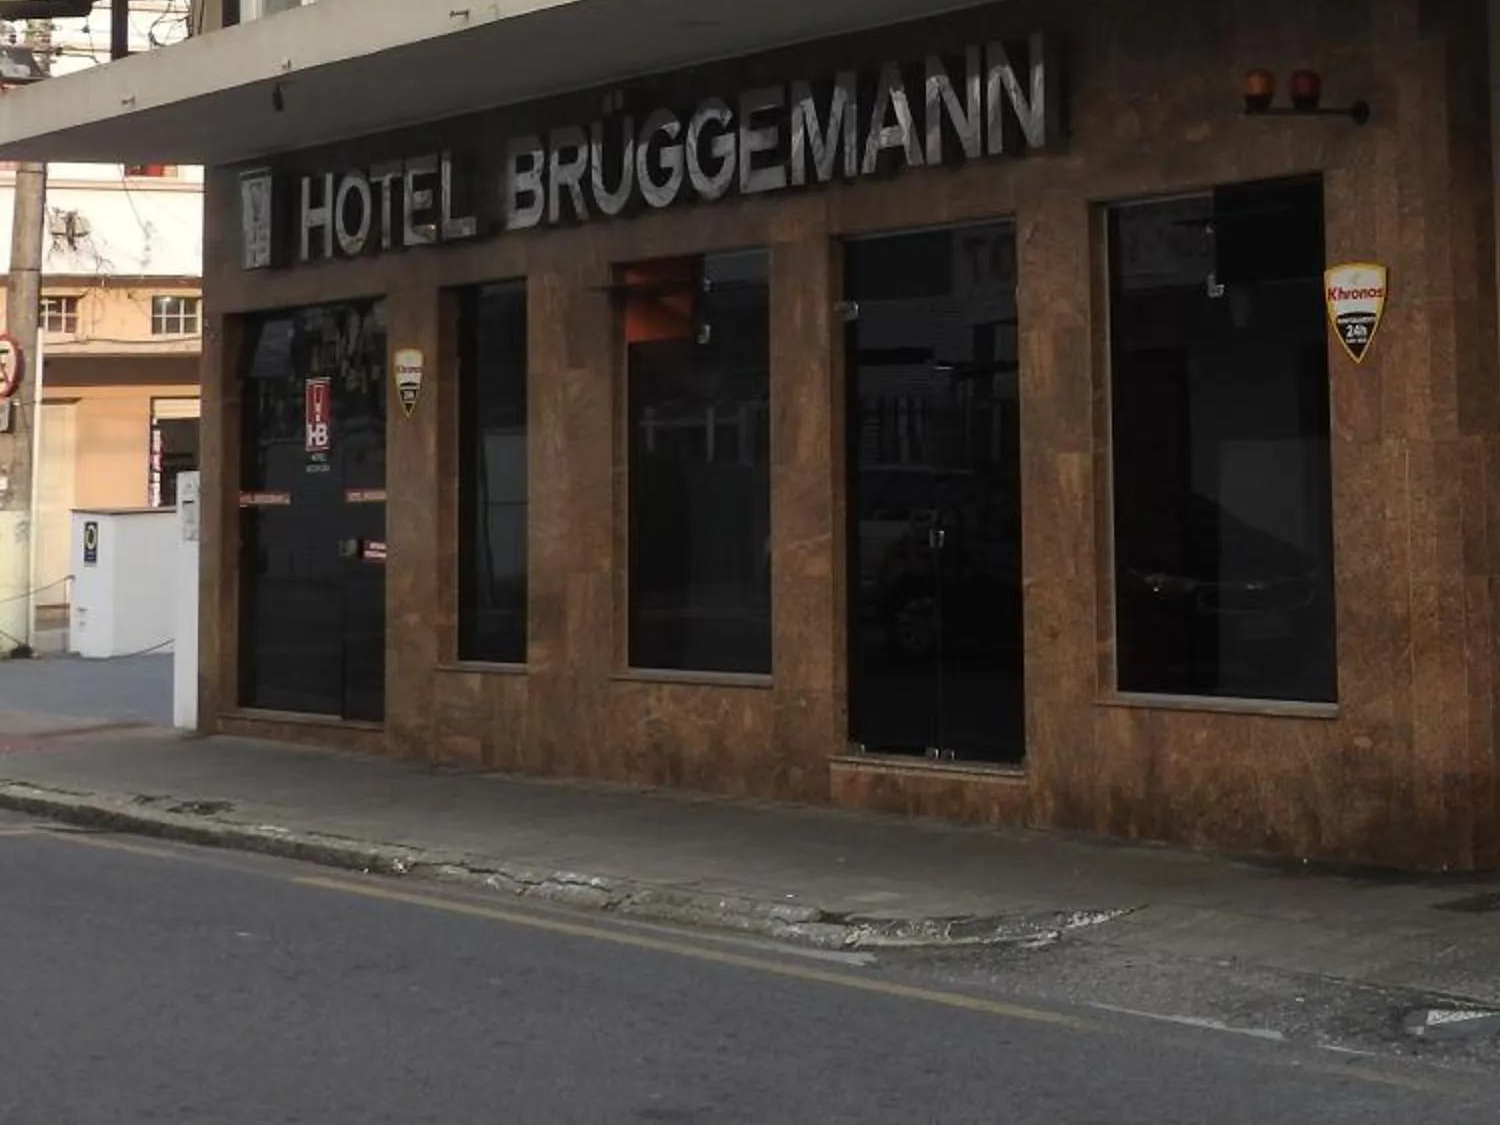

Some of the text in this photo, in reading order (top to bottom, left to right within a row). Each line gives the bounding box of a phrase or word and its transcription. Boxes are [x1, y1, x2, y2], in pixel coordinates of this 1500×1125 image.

[300, 33, 1048, 261] HOTEL BRÜGGEMANN
[1327, 286, 1384, 301] Khronos
[308, 423, 328, 446] HB
